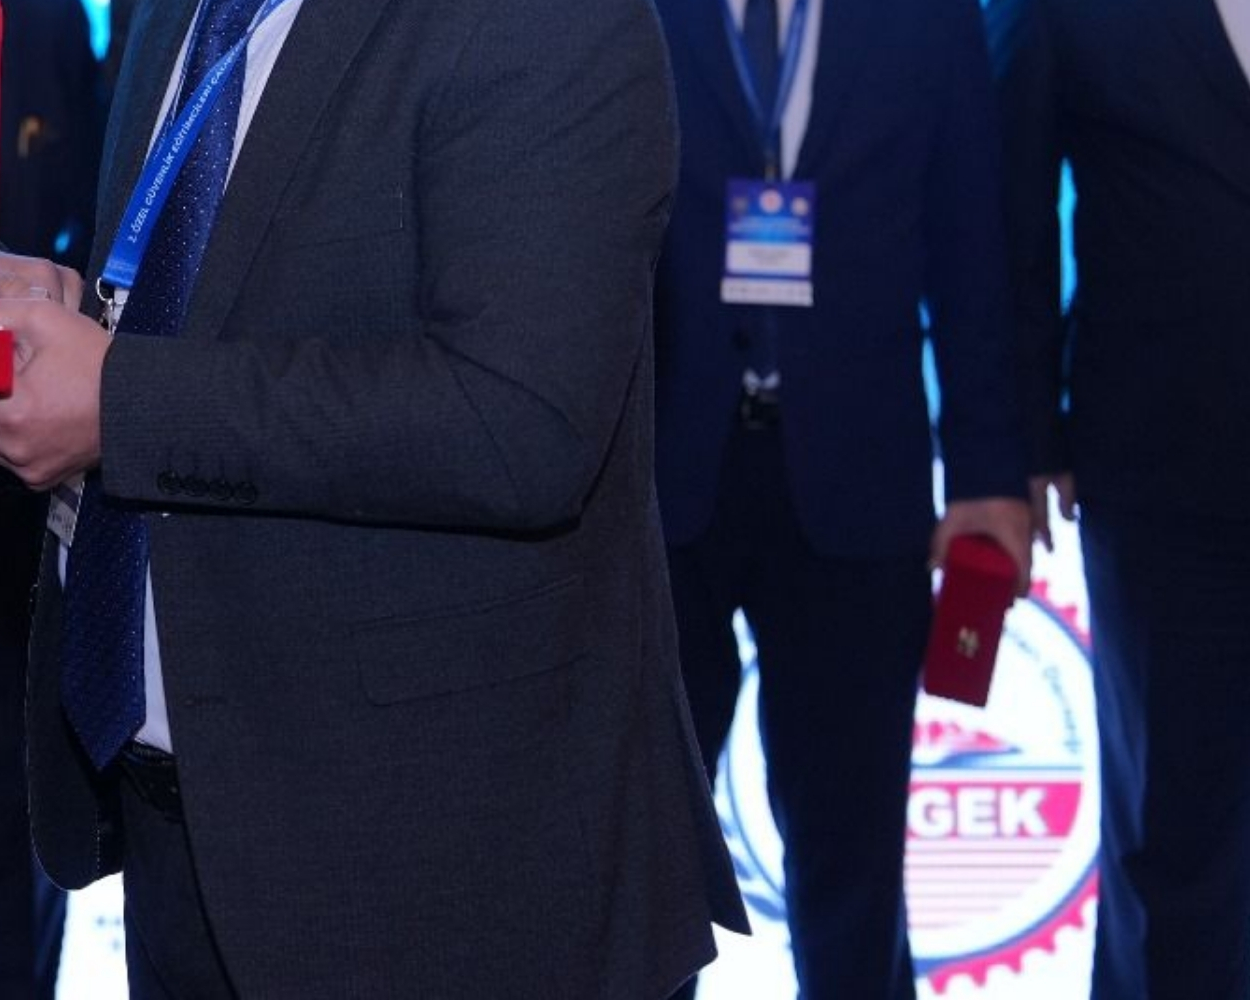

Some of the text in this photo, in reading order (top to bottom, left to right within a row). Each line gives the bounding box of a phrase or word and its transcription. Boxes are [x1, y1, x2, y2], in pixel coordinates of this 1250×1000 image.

[130, 207, 149, 233] ÖZEL
[145, 153, 175, 206] GÜVENLİK
[907, 787, 1048, 839] GEK
